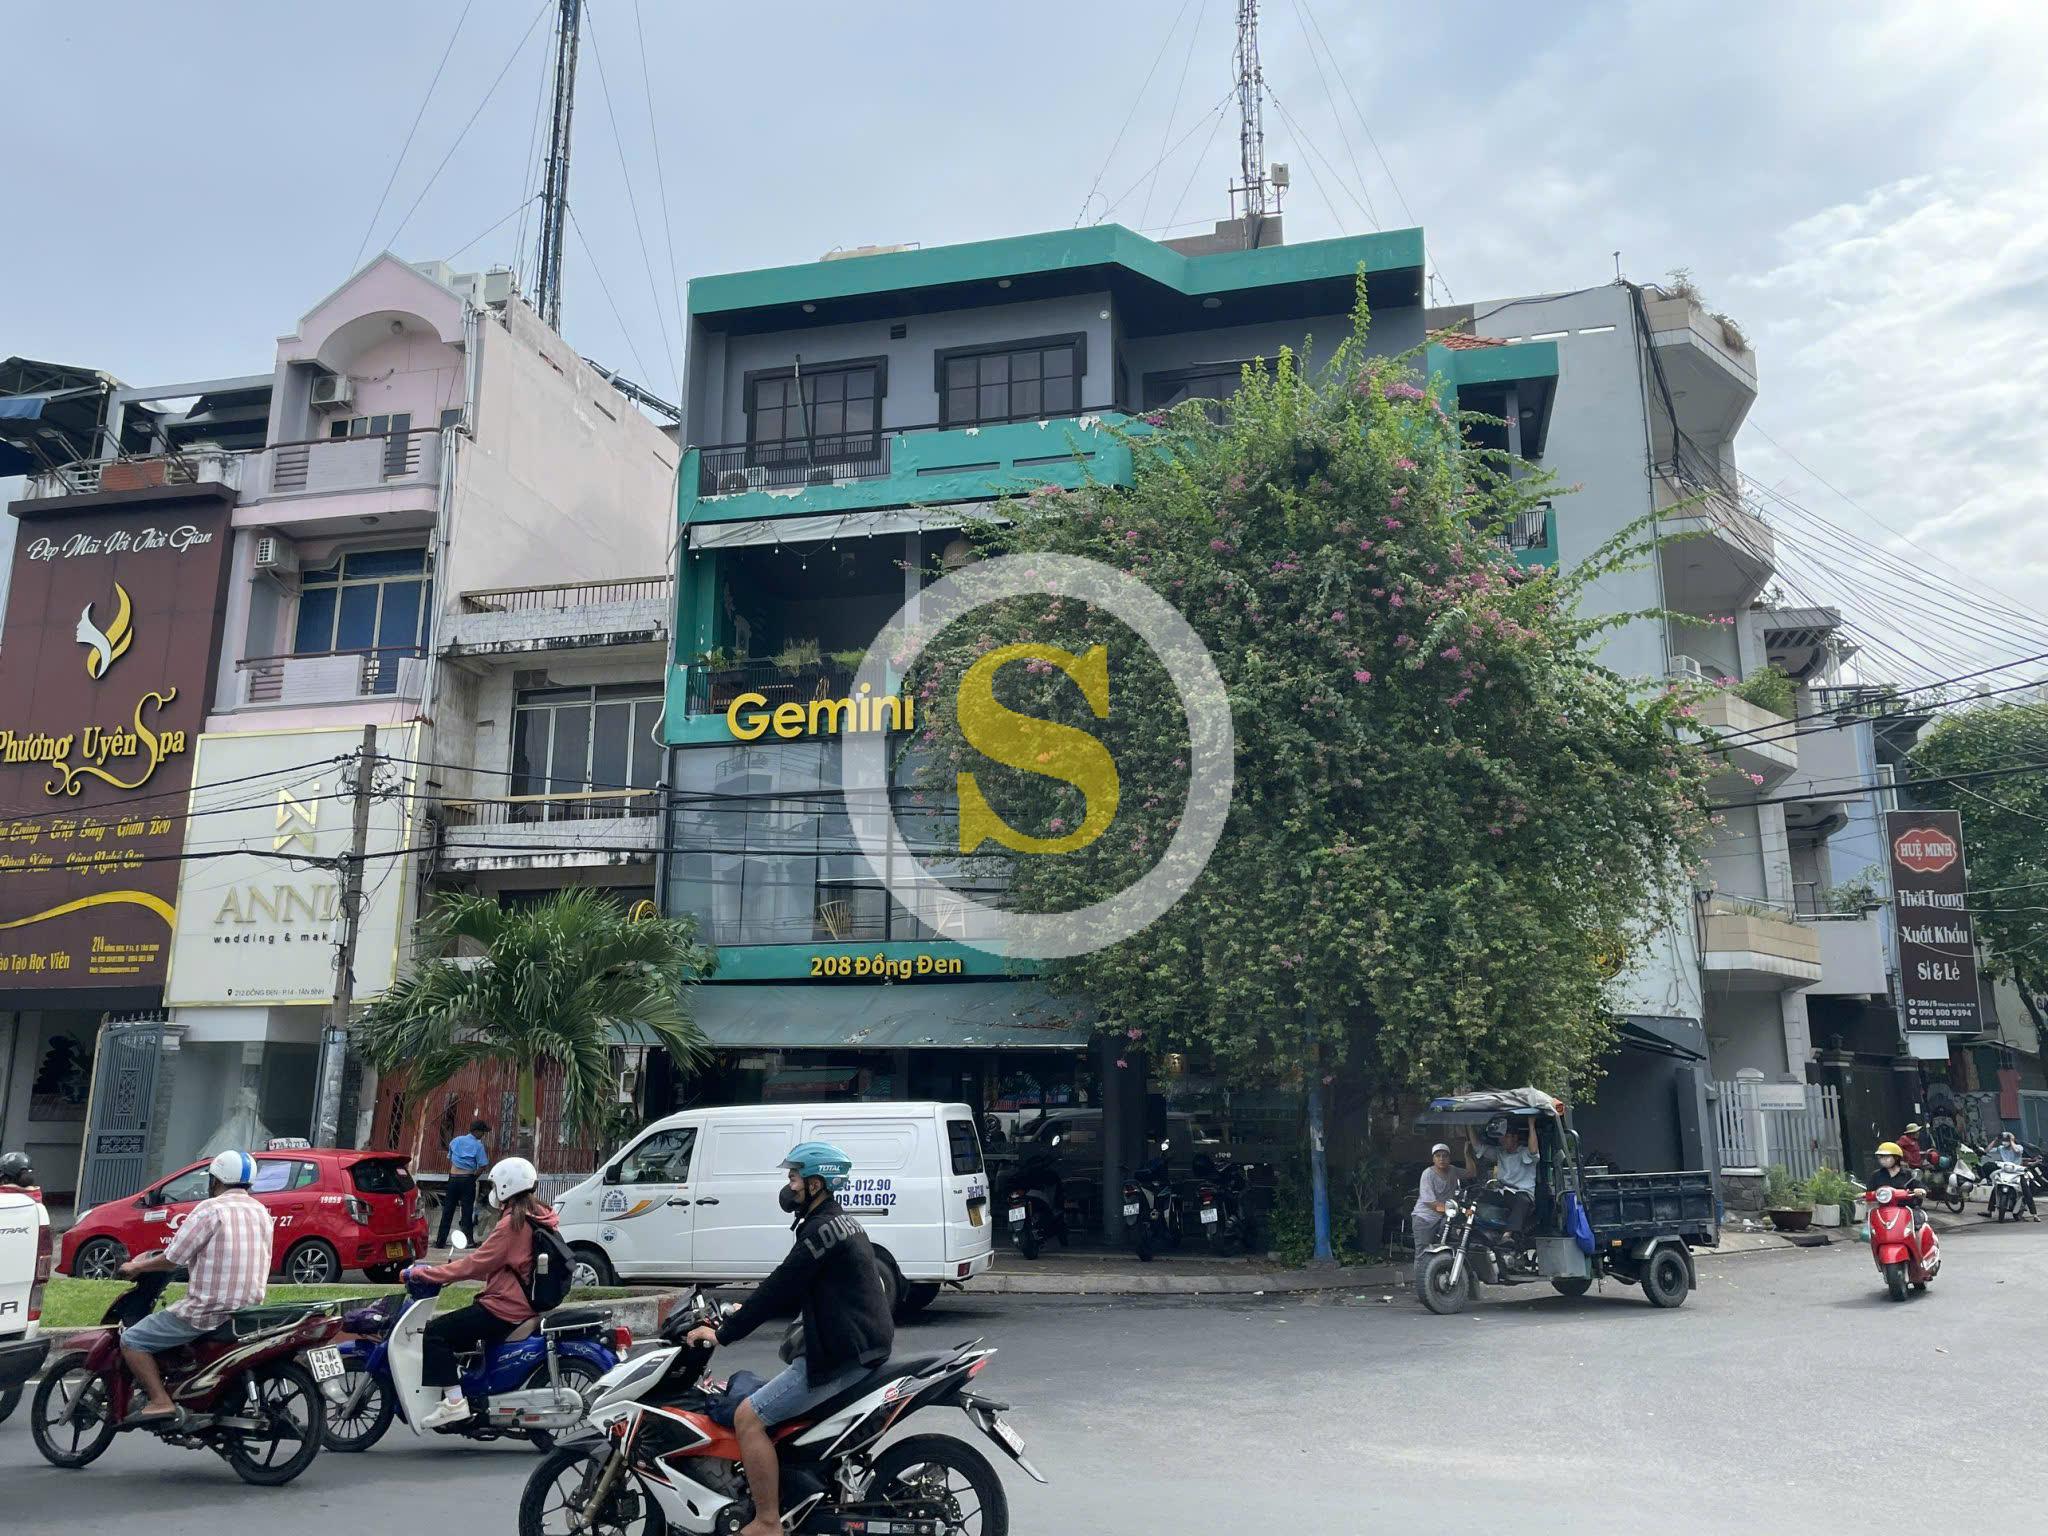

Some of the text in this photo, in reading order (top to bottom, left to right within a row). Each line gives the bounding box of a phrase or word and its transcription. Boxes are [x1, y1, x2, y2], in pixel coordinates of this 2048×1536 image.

[27, 537, 59, 562] Đẹp
[169, 525, 213, 553] Gian
[727, 682, 914, 740] Gemini
[83, 725, 137, 765] Uyên
[1901, 840, 1953, 860] HUỆ MINH
[214, 884, 339, 923] ANNI
[1925, 890, 1965, 910] Trang
[214, 931, 275, 945] wedding
[284, 932, 291, 942] &
[1902, 922, 1968, 944] Xuất Khẩu
[811, 952, 962, 979] 208 Đồng Đen
[1933, 963, 1943, 981] &
[819, 1164, 841, 1172] TOTAL
